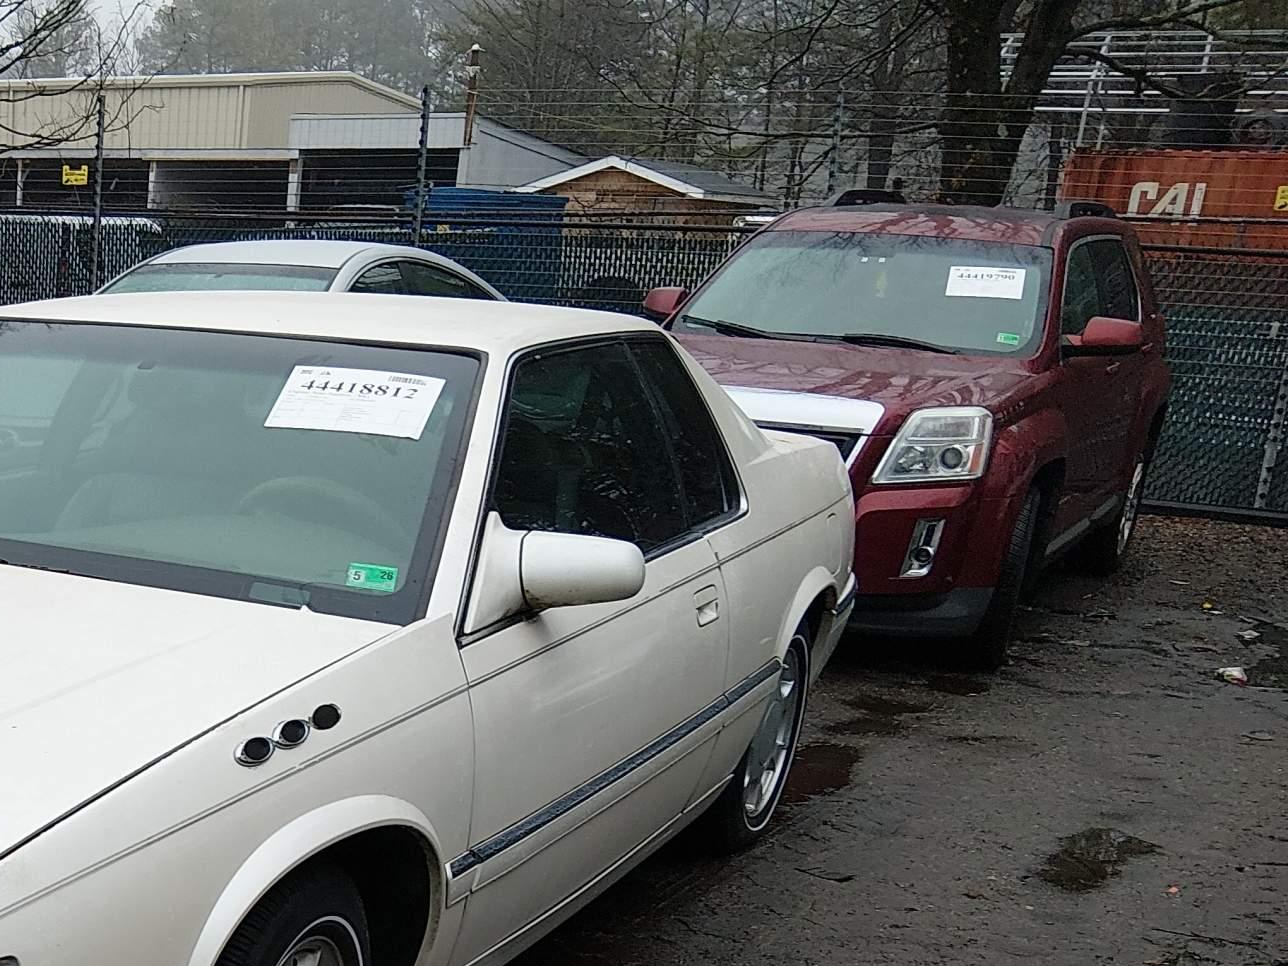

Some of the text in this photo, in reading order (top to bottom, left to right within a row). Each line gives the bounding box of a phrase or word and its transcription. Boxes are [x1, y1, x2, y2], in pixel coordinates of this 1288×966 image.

[1126, 181, 1207, 226] CAI
[300, 379, 419, 400] 44418812
[353, 570, 361, 581] 5
